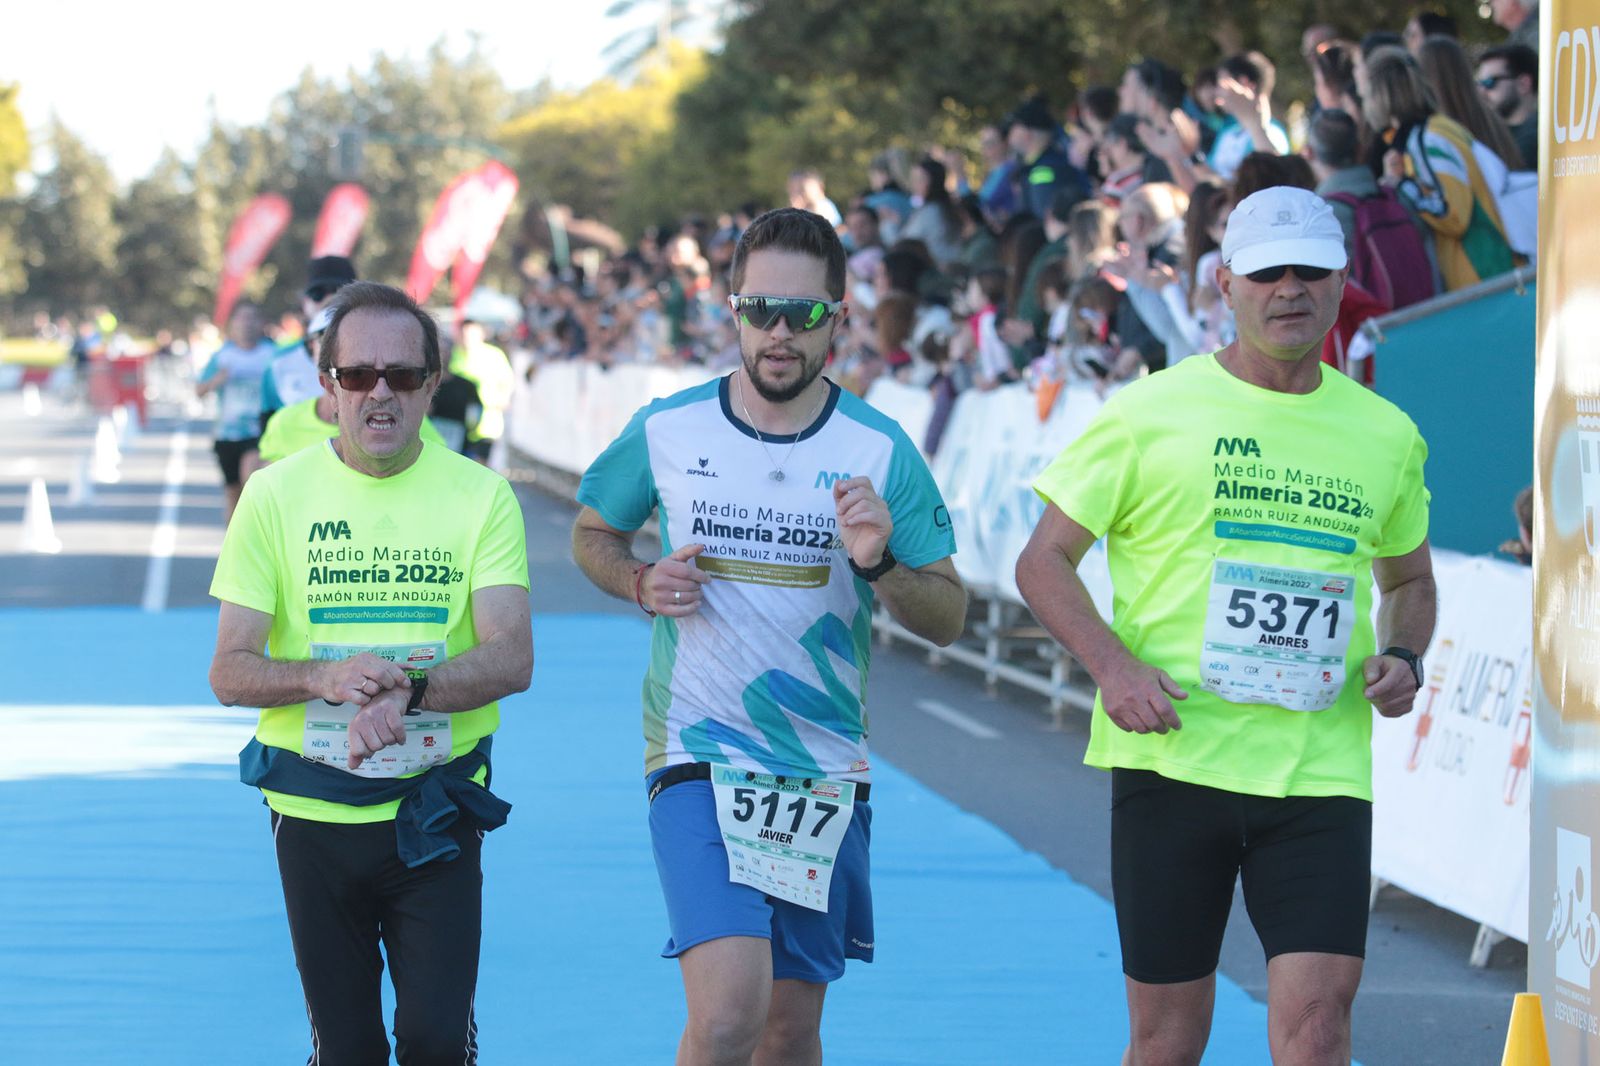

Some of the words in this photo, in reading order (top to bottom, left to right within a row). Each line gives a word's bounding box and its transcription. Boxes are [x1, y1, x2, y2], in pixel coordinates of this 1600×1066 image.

[686, 468, 719, 478] SPALL
[1214, 462, 1276, 481] Medio
[1285, 468, 1364, 496] Maratón
[1214, 480, 1303, 505] Almería
[692, 500, 748, 520] Medio
[757, 507, 836, 529] Maratón
[1214, 507, 1263, 519] RAMÓN
[1267, 511, 1299, 524] RUIZ
[1304, 515, 1361, 536] ANDÚJAR
[692, 517, 773, 544] Almería
[307, 546, 364, 563] Medio
[373, 546, 452, 563] Maratón
[702, 543, 736, 556] AMÓN
[741, 548, 770, 561] RUIZ
[775, 551, 832, 565] ANDÚJAR
[308, 564, 390, 586] Almería
[307, 590, 352, 604] RAMÓN
[357, 592, 388, 602] RUIZ
[392, 590, 451, 603] ANDÚJAR
[1226, 588, 1340, 639] 5371
[1258, 633, 1309, 649] ANDRES
[732, 788, 839, 838] 5117
[757, 828, 794, 845] JAVIER
